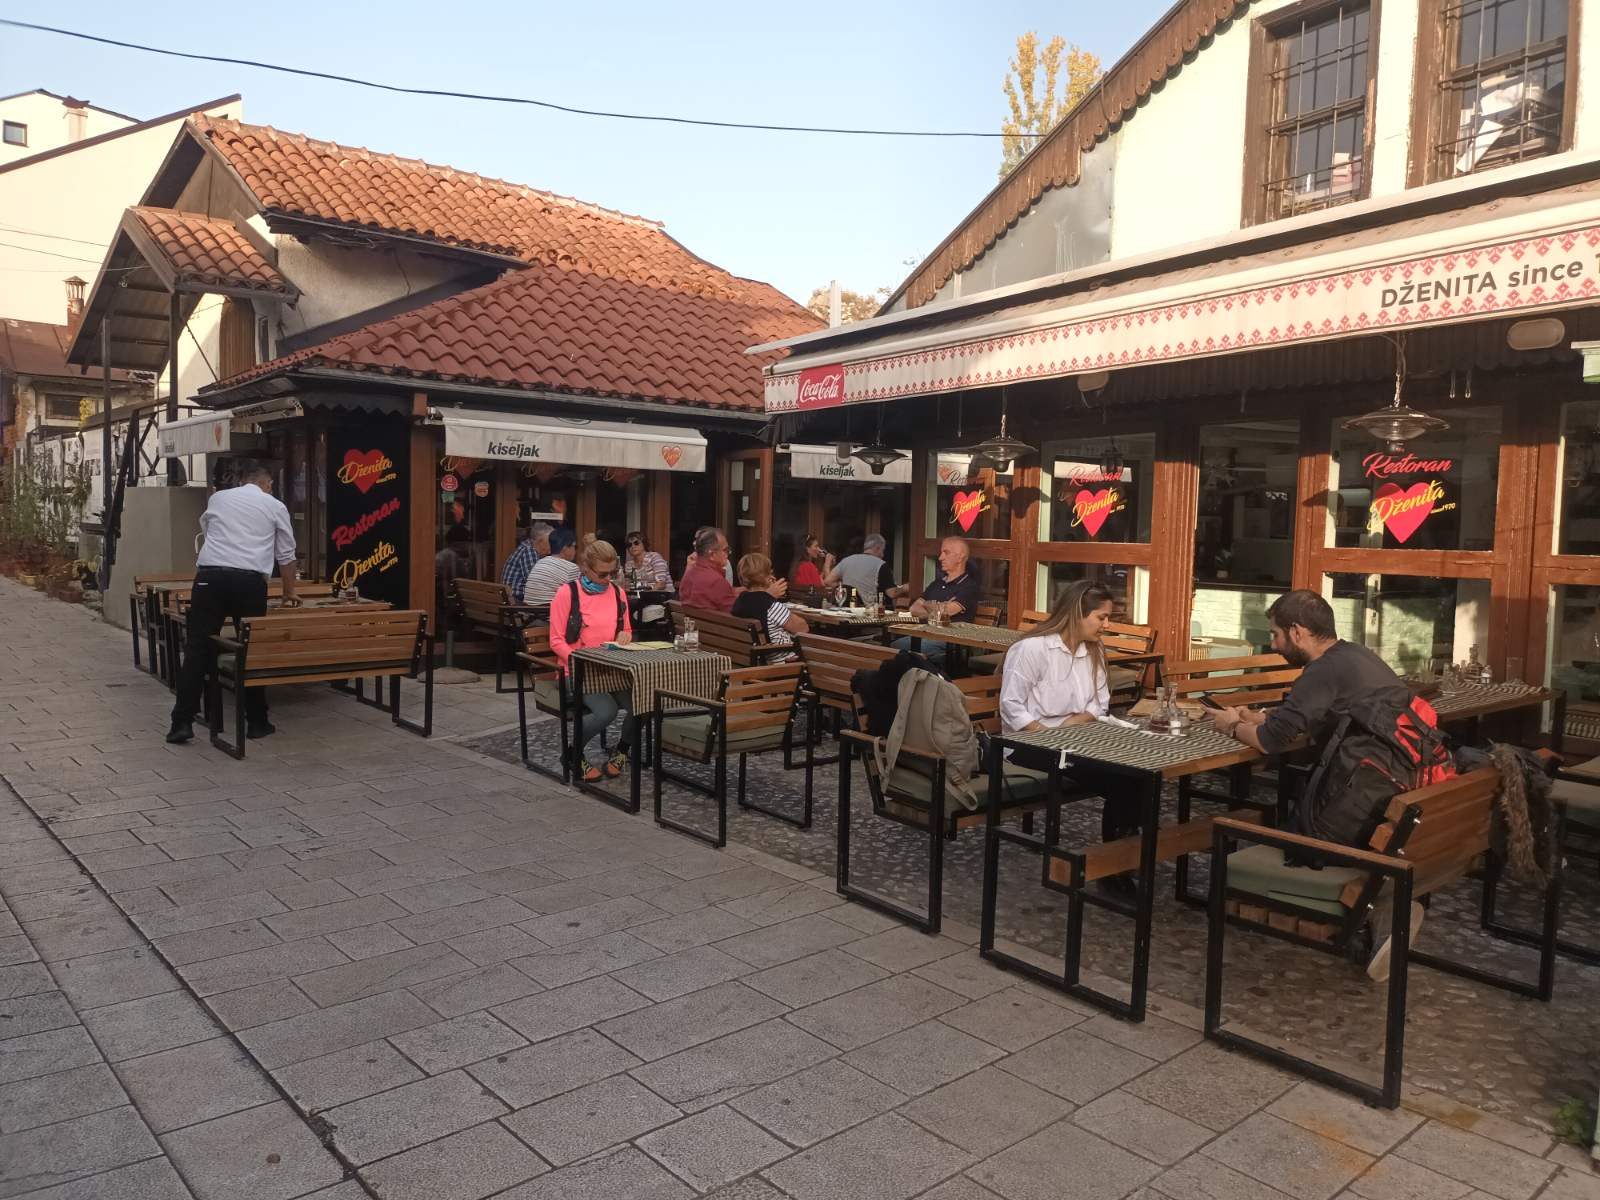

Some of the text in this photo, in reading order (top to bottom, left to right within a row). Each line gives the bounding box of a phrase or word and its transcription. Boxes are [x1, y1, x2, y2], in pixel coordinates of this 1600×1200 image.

[1381, 271, 1497, 308] DŽENITA
[1508, 260, 1584, 288] since
[487, 441, 540, 458] kiseljak
[1362, 451, 1452, 478] Restoran
[819, 465, 855, 478] kiseljak
[1366, 479, 1445, 530] Dženita
[331, 497, 401, 551] Restoran
